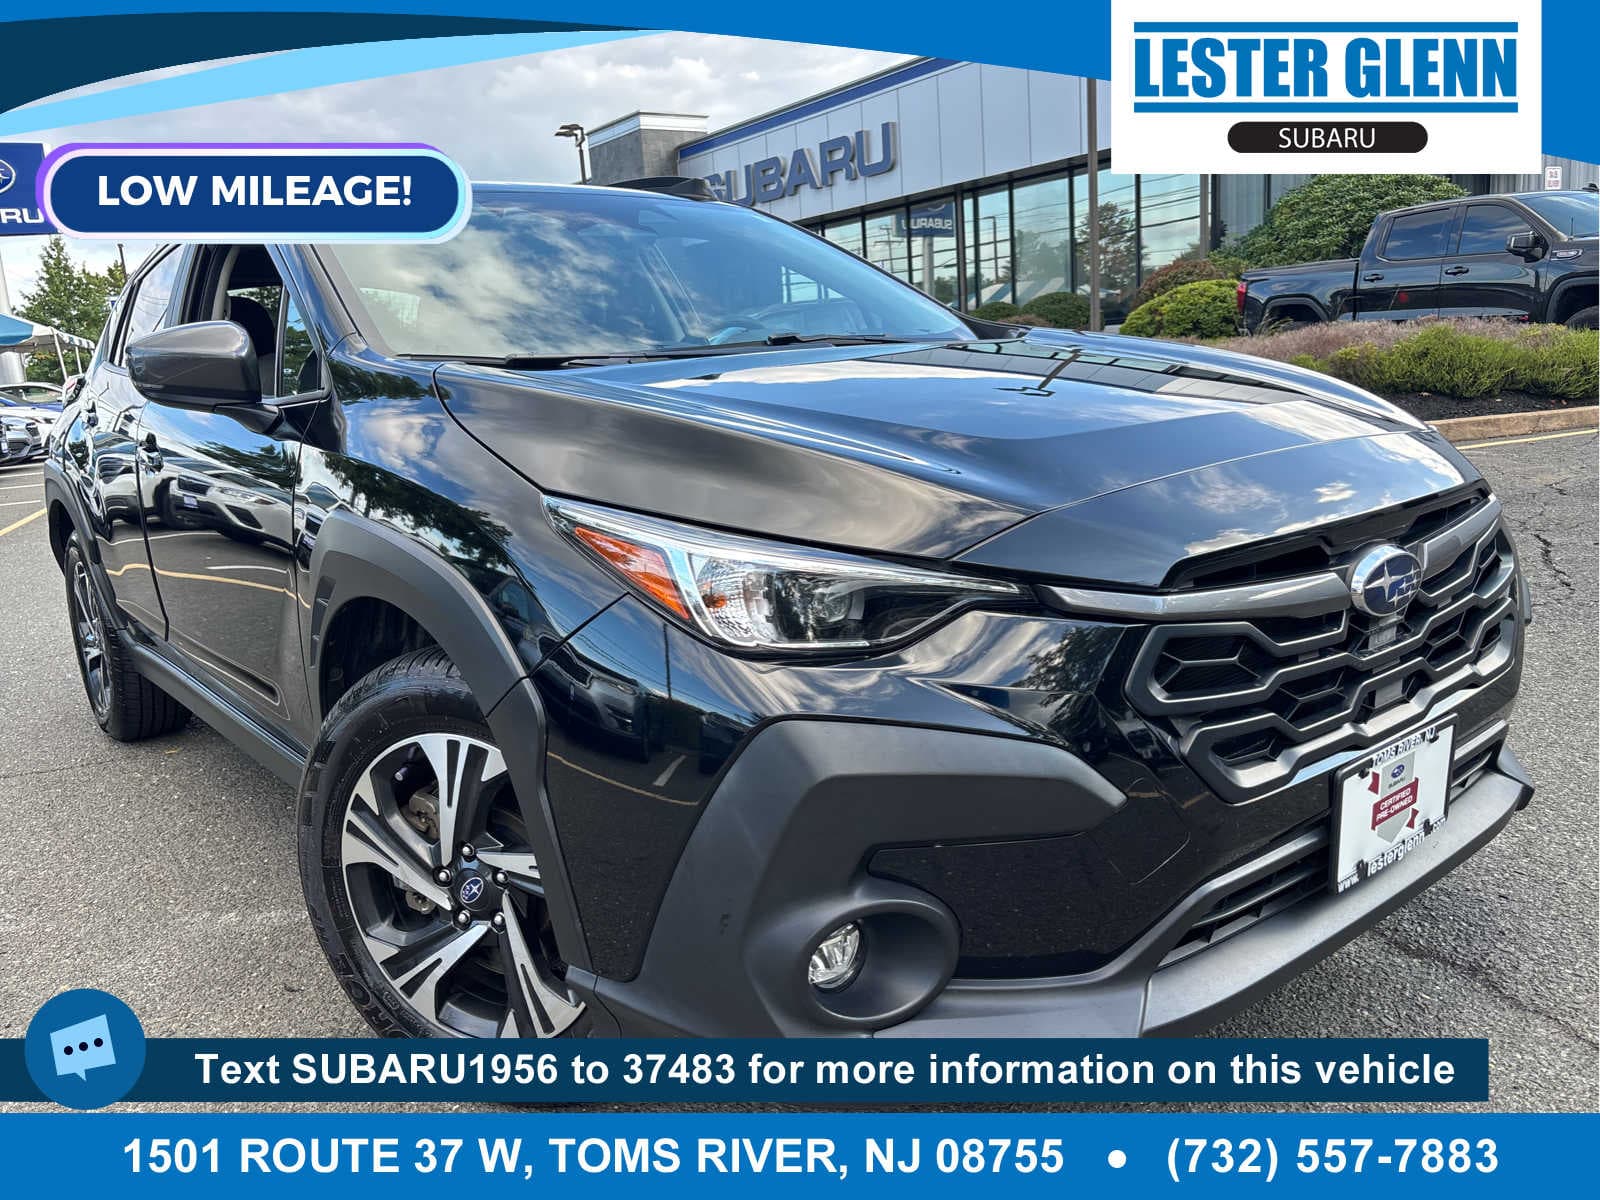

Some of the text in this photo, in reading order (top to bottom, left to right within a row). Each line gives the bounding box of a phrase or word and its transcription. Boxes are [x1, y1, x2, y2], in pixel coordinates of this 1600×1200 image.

[704, 122, 897, 207] SUBARU
[1373, 746, 1397, 767] TOMS
[1376, 795, 1413, 823] PRE-OWNED
[1379, 787, 1411, 811] CERTIFIED
